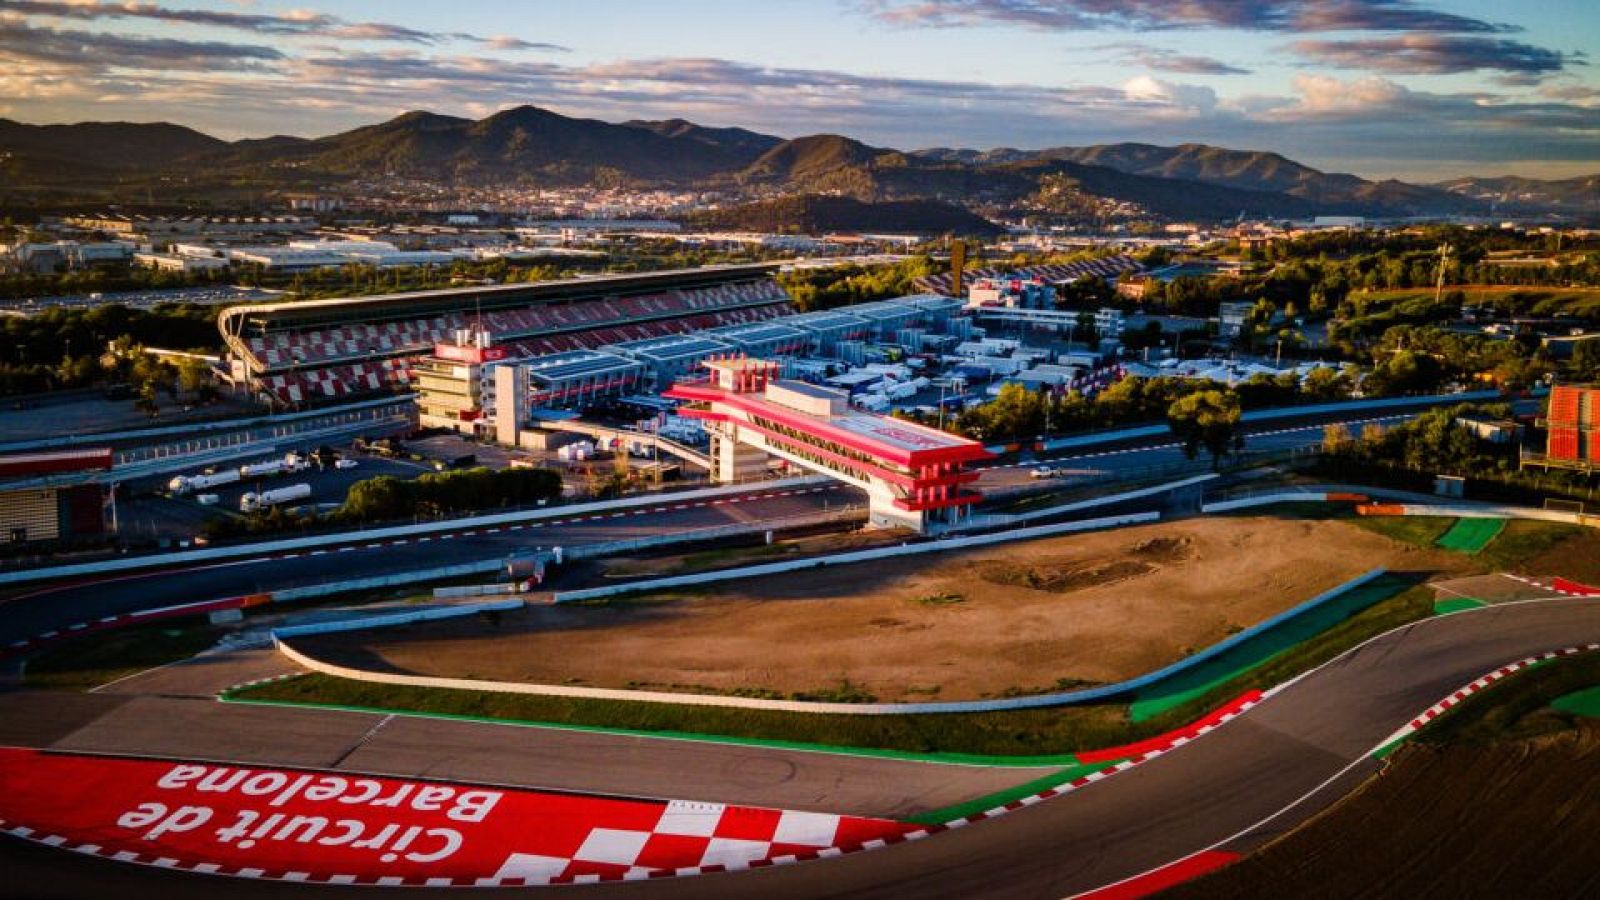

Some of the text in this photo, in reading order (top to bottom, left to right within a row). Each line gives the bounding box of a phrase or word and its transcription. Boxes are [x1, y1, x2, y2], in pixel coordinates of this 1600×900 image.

[157, 764, 503, 823] Barcelona
[117, 802, 463, 863] Circuit de
